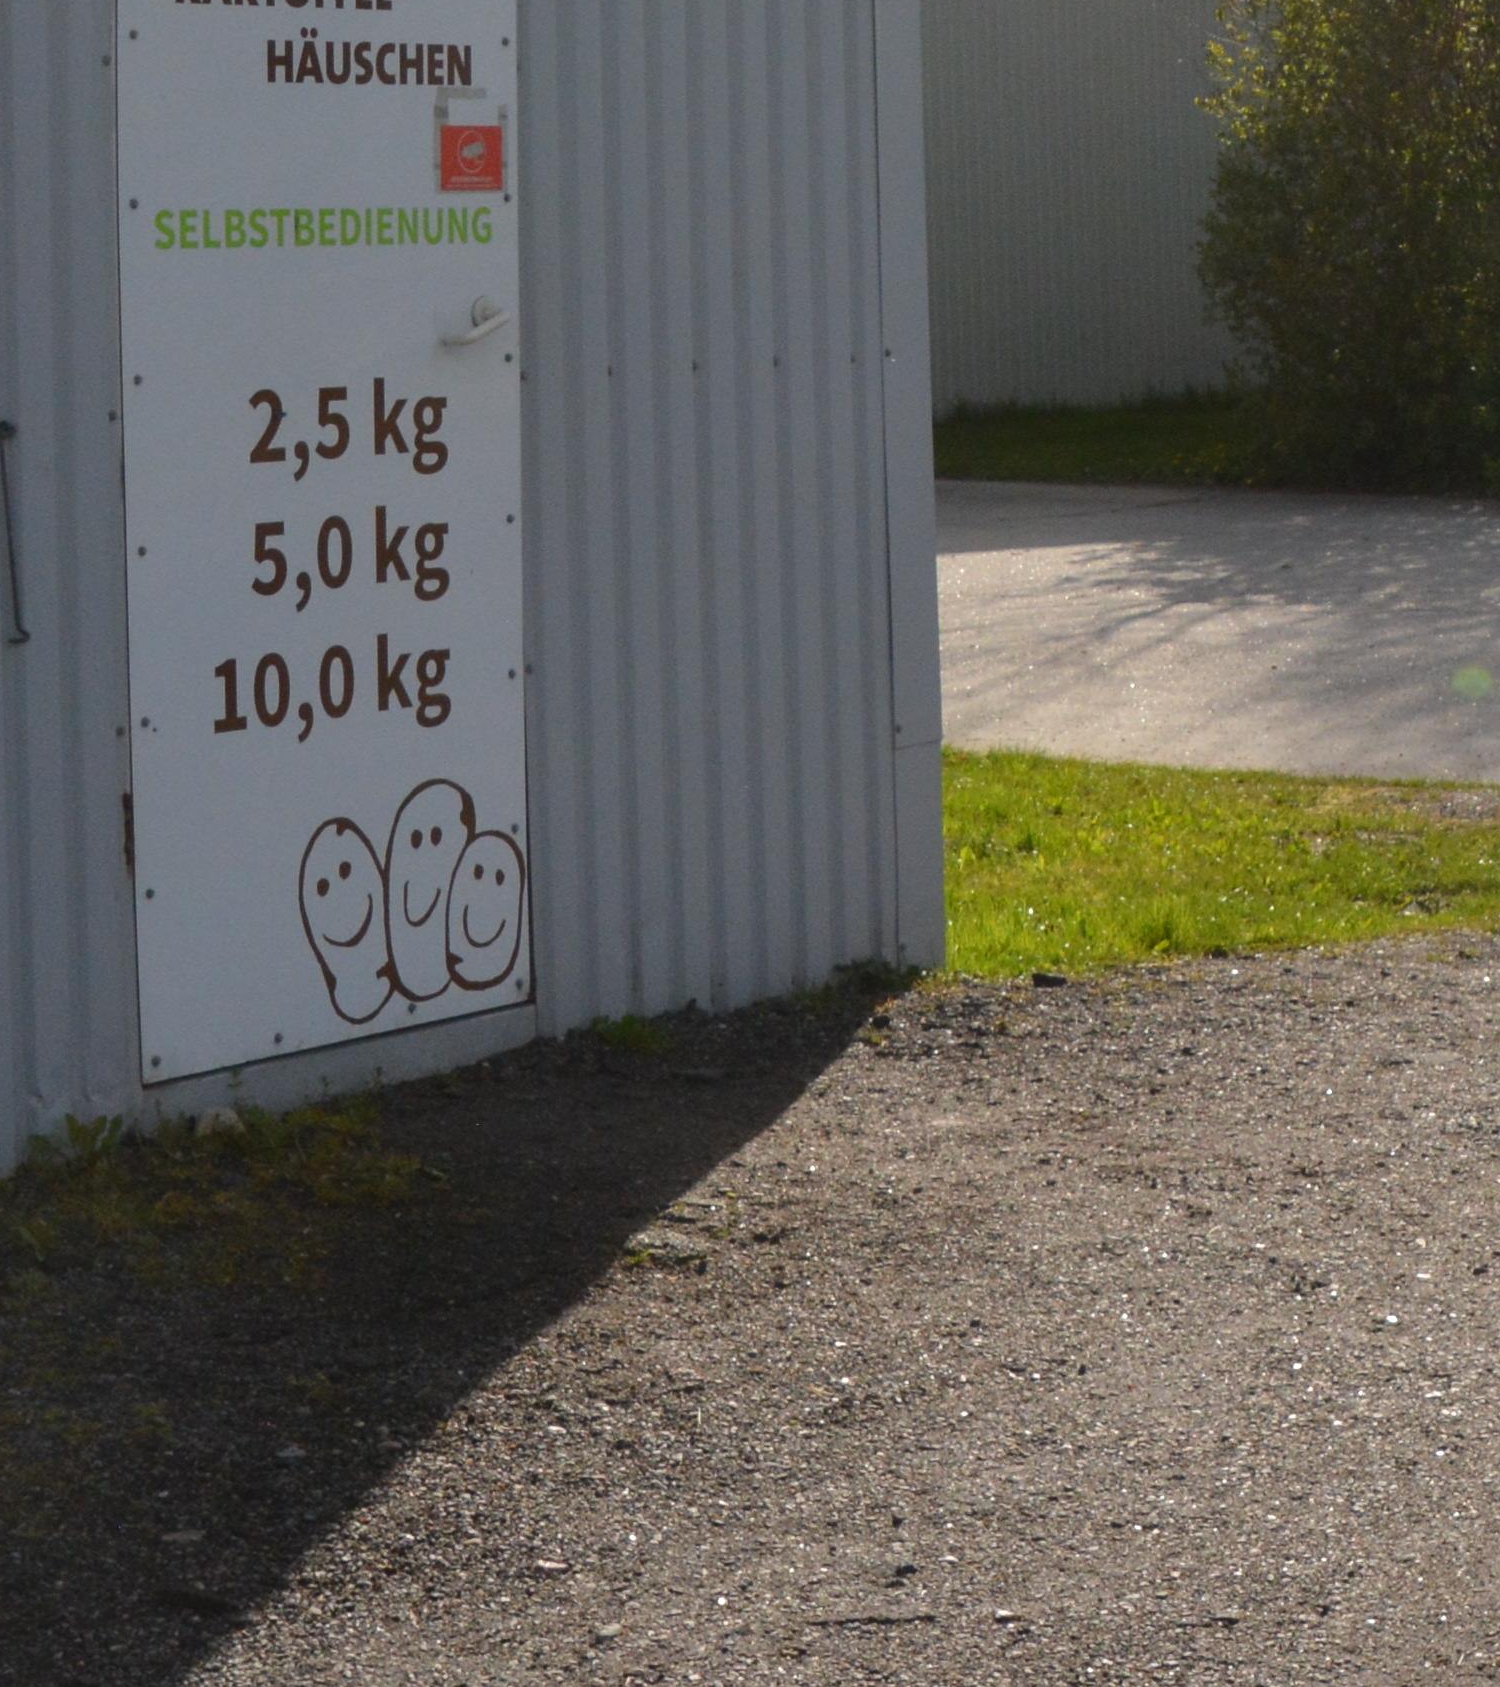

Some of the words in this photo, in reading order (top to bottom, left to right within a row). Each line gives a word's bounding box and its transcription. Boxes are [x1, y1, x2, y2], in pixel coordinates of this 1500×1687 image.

[266, 27, 472, 86] HÄUSCHEN
[154, 206, 493, 250] SELBSTBEDIENUNG
[248, 385, 351, 482] 2,5
[373, 377, 449, 475] kg
[250, 514, 353, 613] 5,0
[375, 505, 451, 602] kg
[213, 644, 355, 743] 10,0
[376, 633, 453, 729] kg
